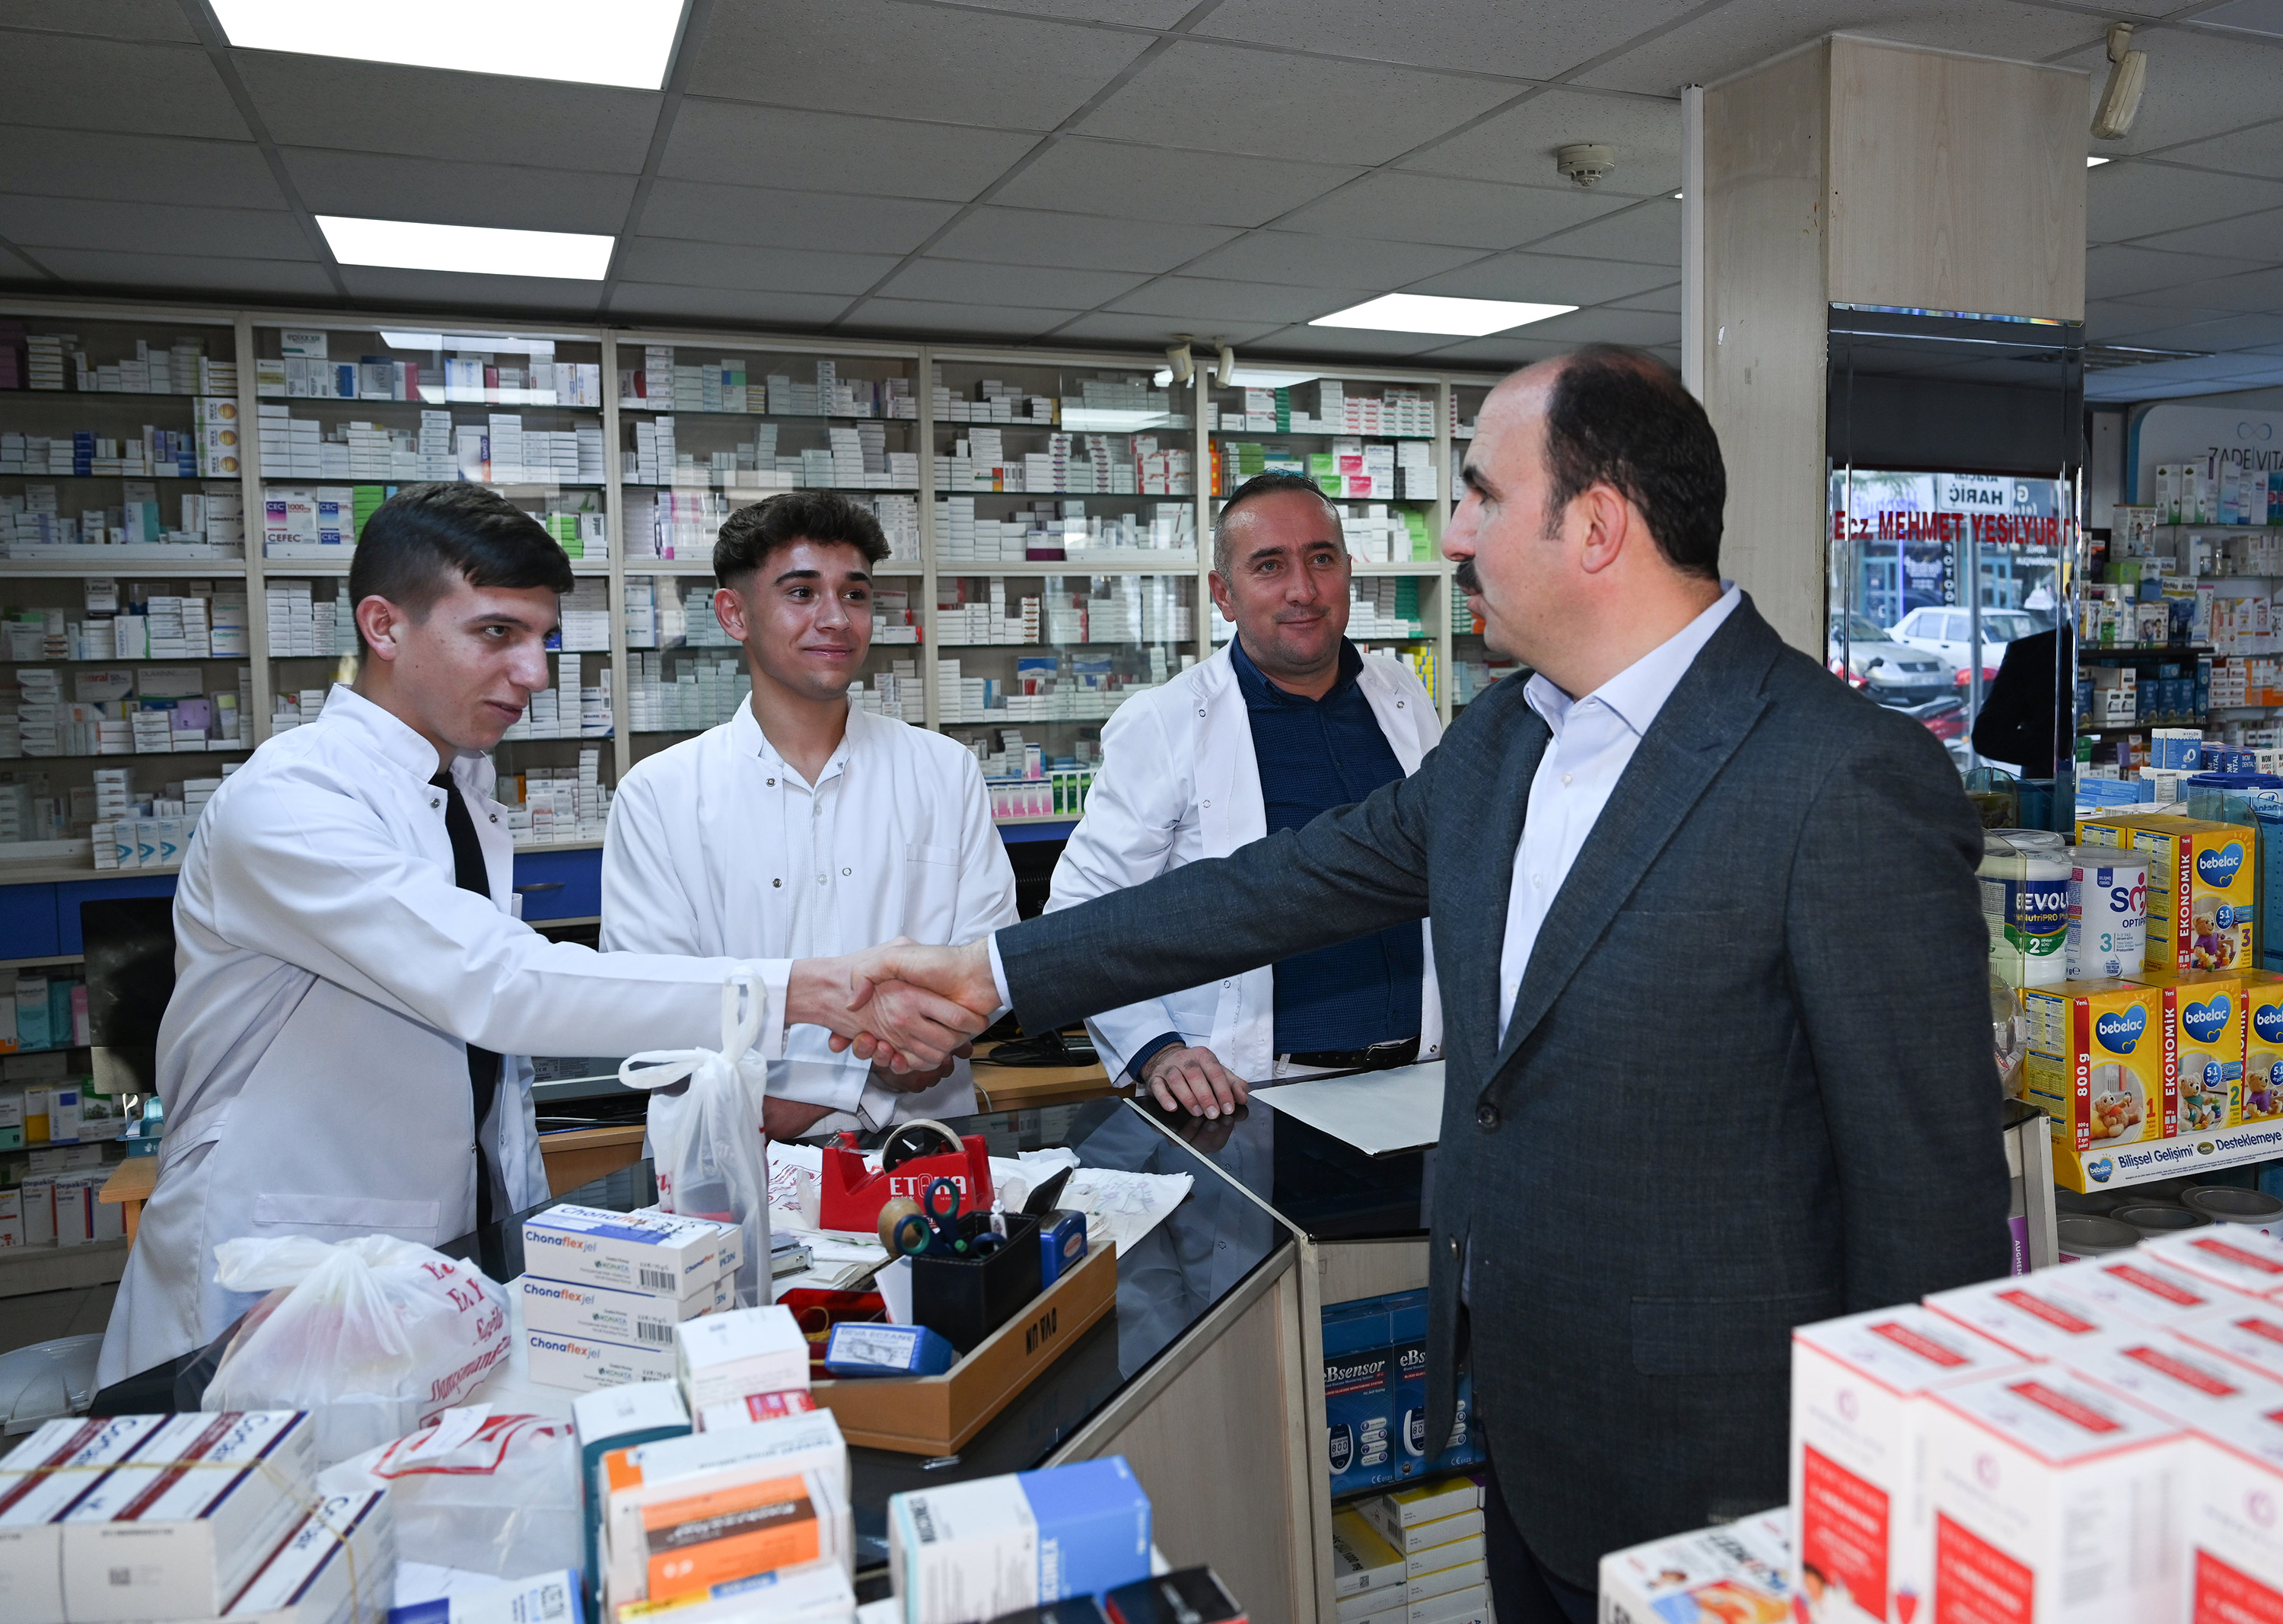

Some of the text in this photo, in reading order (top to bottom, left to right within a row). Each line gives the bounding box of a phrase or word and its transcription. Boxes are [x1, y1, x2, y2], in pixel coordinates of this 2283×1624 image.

[1879, 511, 1963, 542] MEHMET
[267, 533, 301, 543] CEFEC
[2199, 855, 2239, 870] bebelac
[2180, 854, 2190, 937] EKONOMİK
[2030, 938, 2040, 954] 2
[2100, 933, 2113, 952] 3
[2241, 928, 2250, 947] 3
[2186, 1008, 2227, 1024] bebelac
[2099, 1019, 2142, 1035] bebelac
[2165, 1008, 2175, 1096] EKONOMİK
[2077, 1053, 2090, 1097] 800 g
[2230, 1085, 2240, 1106] 2
[2146, 1097, 2156, 1118] 1
[2118, 1151, 2153, 1169] Bilişsel
[2215, 1130, 2281, 1151] Desteklemeye
[2089, 1164, 2111, 1175] bebelac
[1323, 1359, 1385, 1383] eBsensor
[1332, 1442, 1348, 1452] 800
